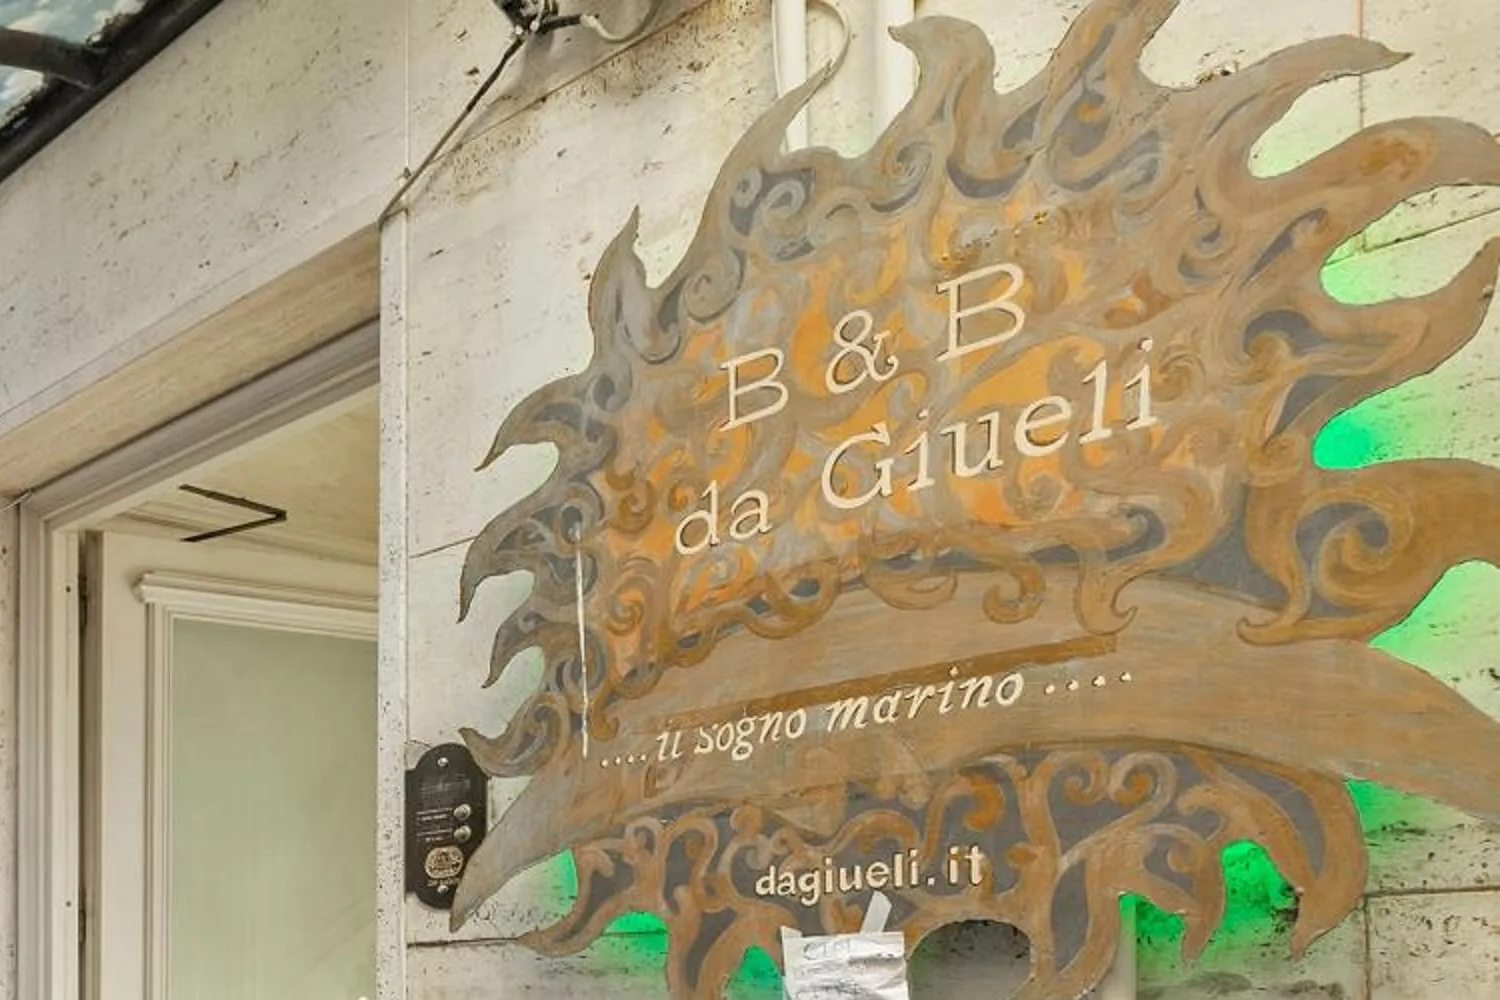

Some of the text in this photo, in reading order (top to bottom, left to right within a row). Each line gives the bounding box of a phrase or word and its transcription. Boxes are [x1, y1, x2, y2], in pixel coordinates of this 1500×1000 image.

[719, 261, 1025, 432] B & B
[673, 336, 1158, 556] da Giueli
[693, 706, 808, 762] sogno
[823, 665, 1025, 733] marino
[754, 845, 985, 907] dagiueli.it
